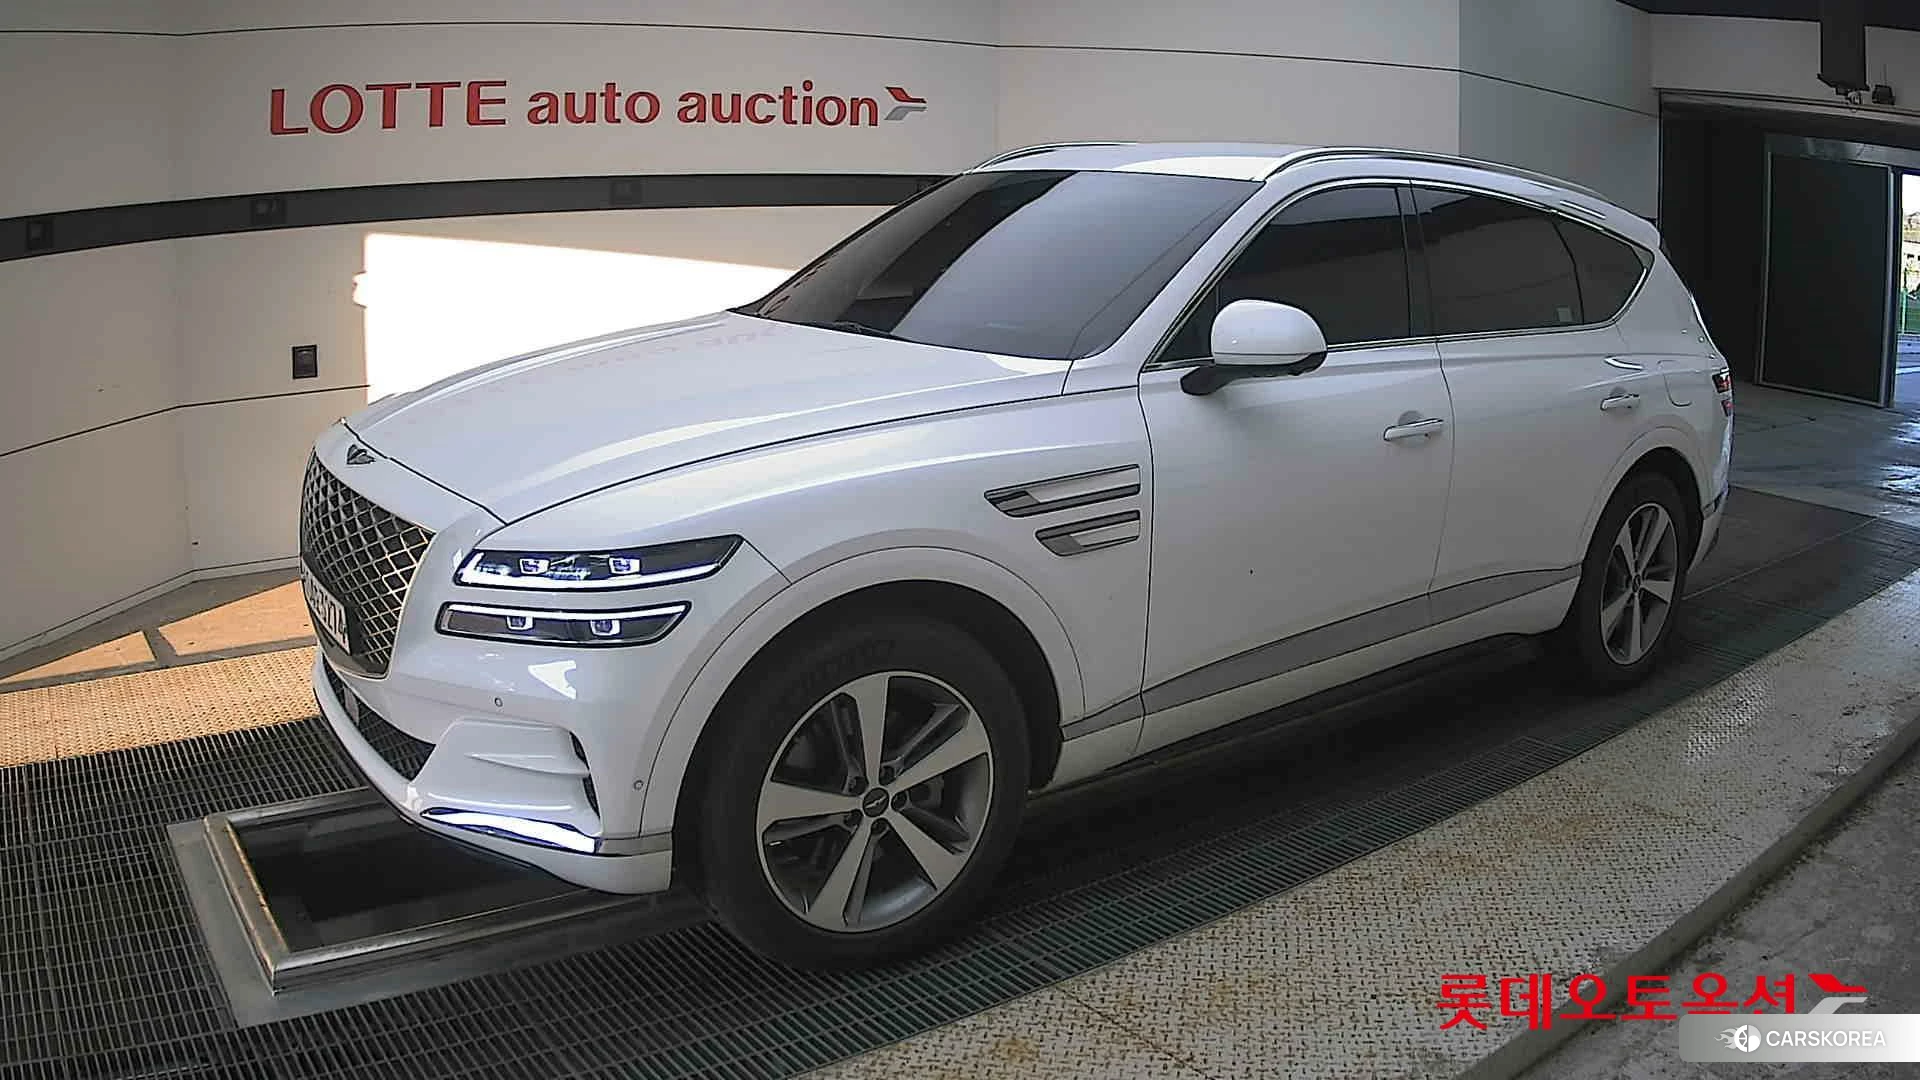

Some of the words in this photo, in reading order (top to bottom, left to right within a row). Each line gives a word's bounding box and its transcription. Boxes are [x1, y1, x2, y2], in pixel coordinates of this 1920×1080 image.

[270, 80, 507, 136] LOTTE
[527, 82, 661, 125] auto
[677, 80, 879, 127] auction
